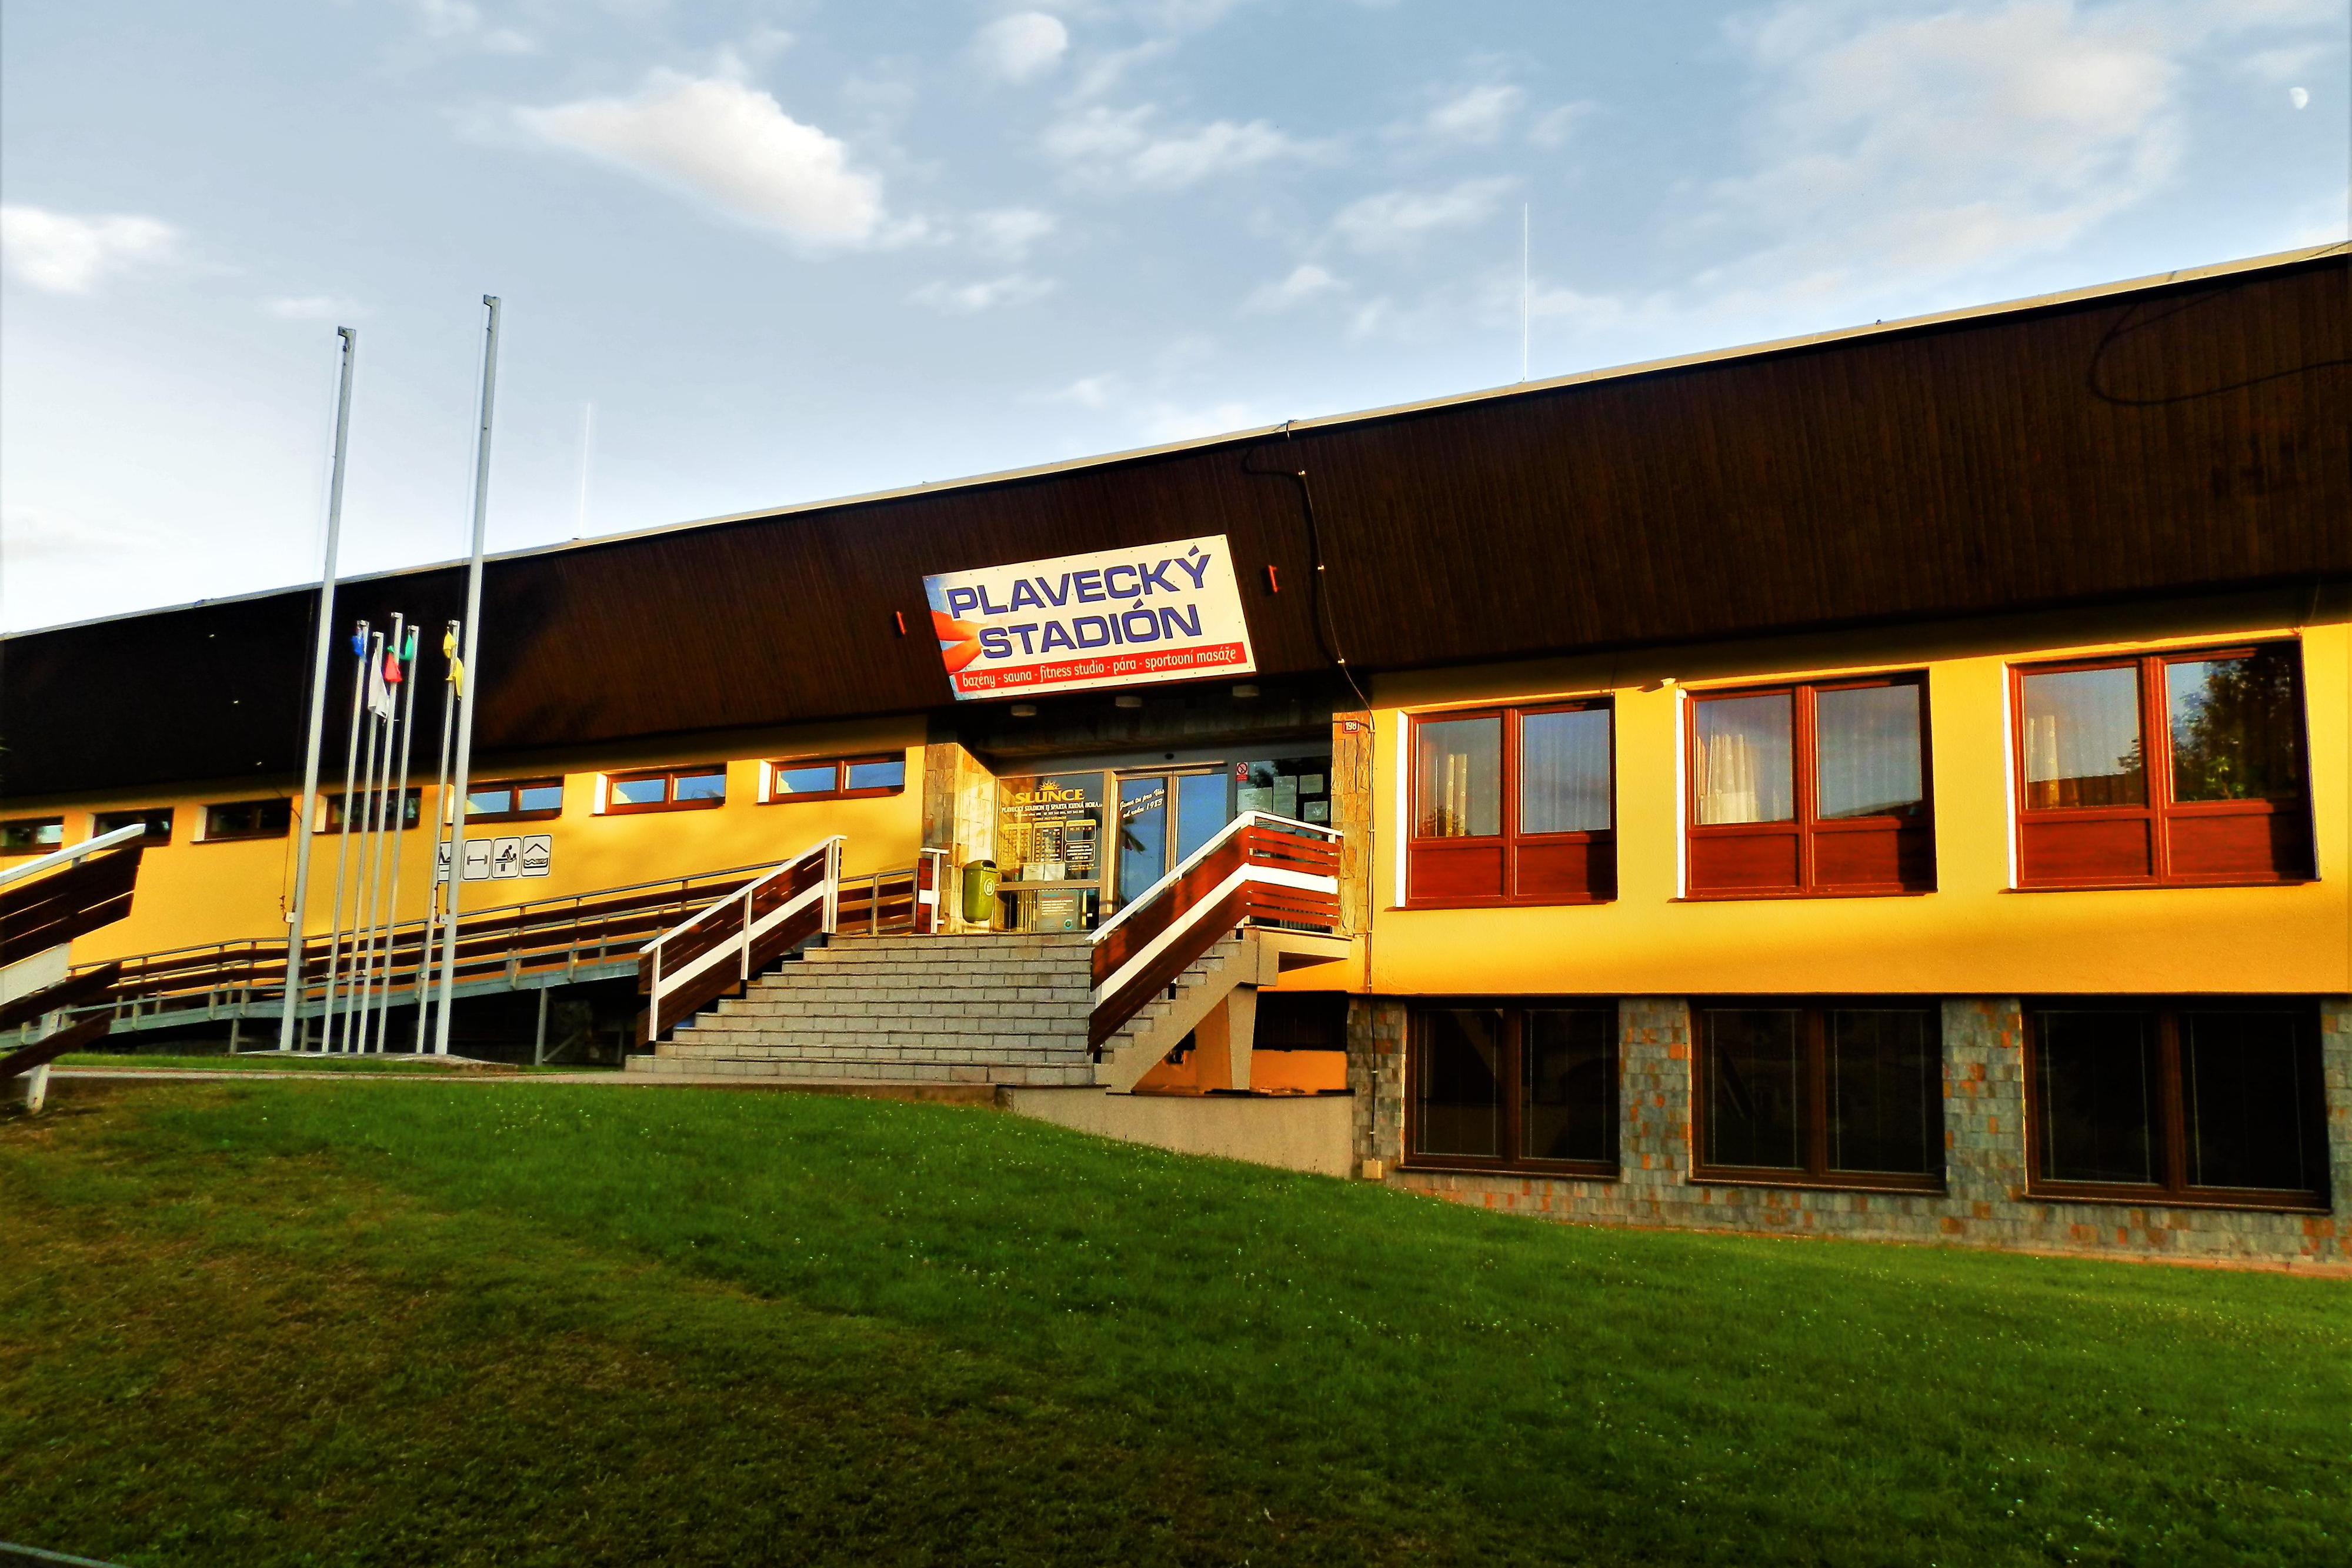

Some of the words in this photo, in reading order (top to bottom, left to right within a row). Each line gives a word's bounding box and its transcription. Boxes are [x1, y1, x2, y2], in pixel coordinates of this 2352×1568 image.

[948, 545, 1211, 619] PLAVECKÝ
[979, 598, 1202, 659] STADIÓN
[962, 673, 996, 689] bazény
[1003, 671, 1032, 683] sauna
[1040, 665, 1072, 683] fitness
[1075, 661, 1105, 675] studio
[1113, 656, 1136, 675] pára
[1145, 650, 1193, 671] sportovní
[1197, 646, 1236, 663] masáže
[1345, 721, 1357, 730] 198
[1015, 789, 1085, 804] SLUNCE
[1146, 798, 1163, 810] 1983
